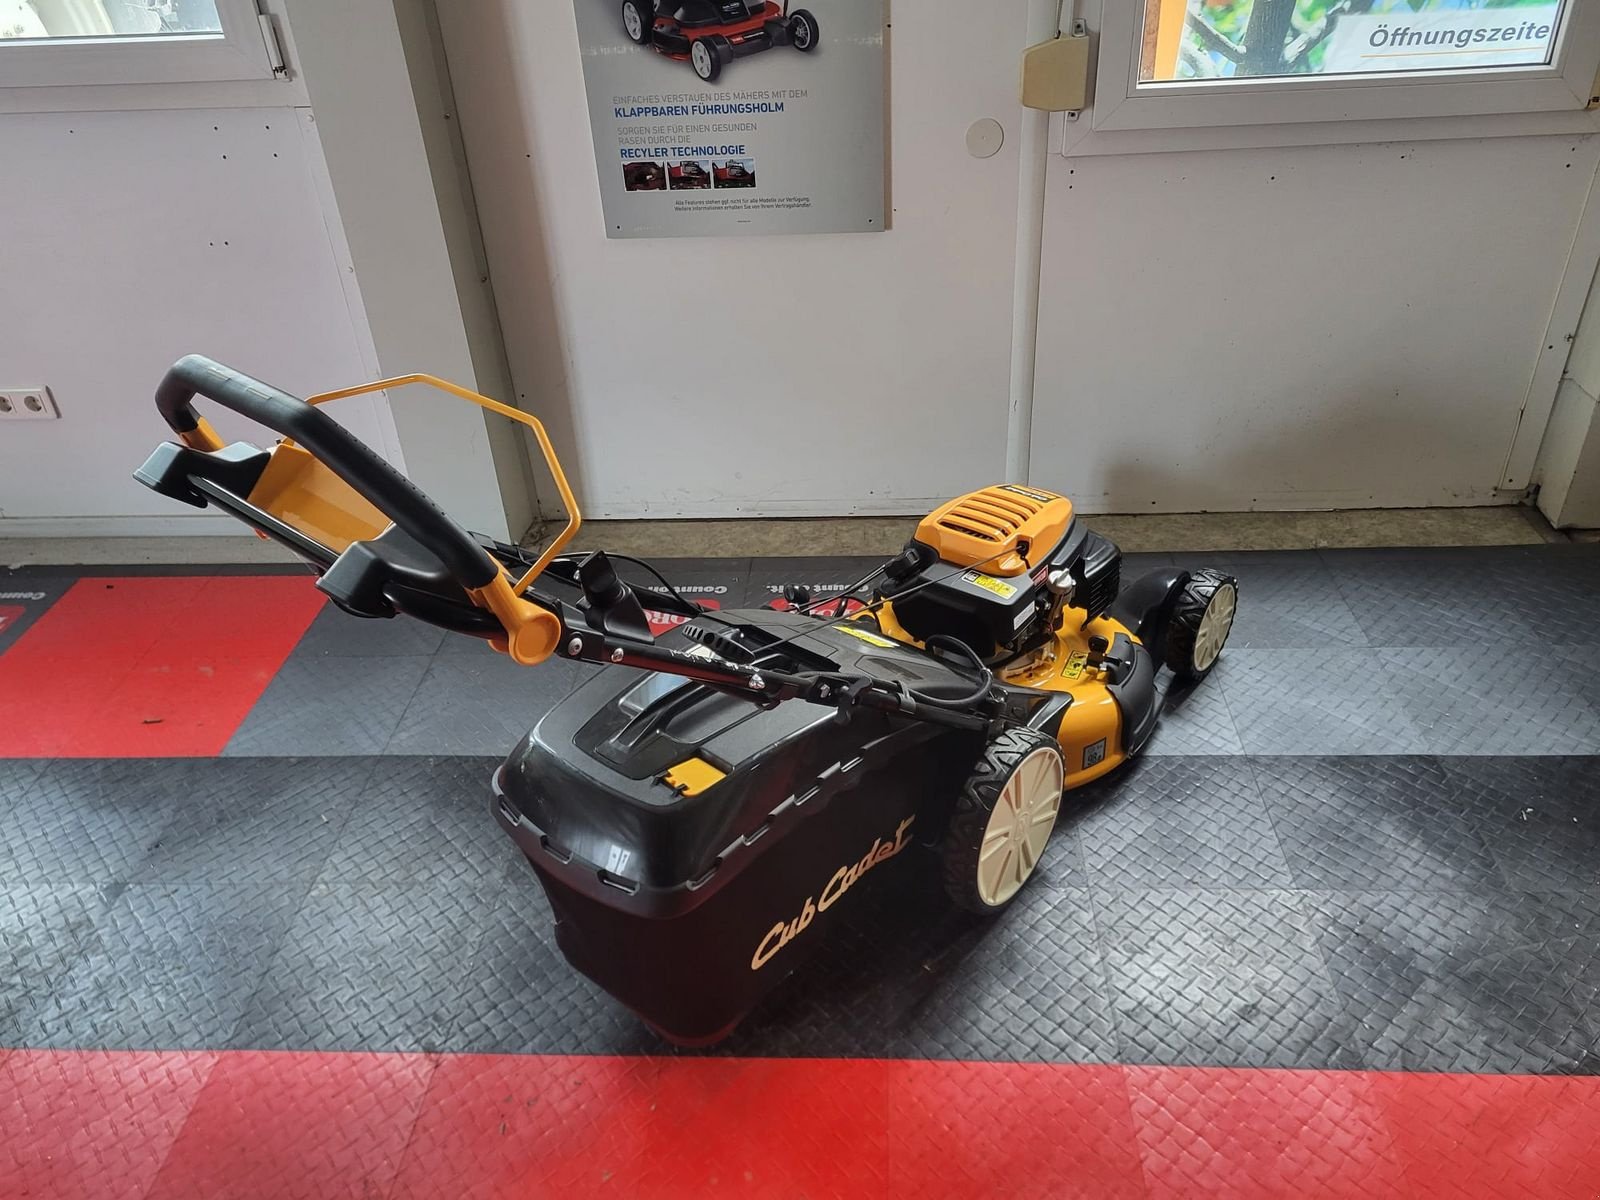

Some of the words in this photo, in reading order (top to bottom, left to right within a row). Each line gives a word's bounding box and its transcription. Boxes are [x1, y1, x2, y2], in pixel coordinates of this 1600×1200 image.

[1369, 21, 1550, 49] Öffnungszeite
[612, 95, 660, 105] EINFACHES
[661, 93, 712, 103] VERSTAUEN
[713, 92, 731, 101] DES
[771, 90, 787, 99] MIT
[788, 89, 808, 98] DEM
[614, 105, 689, 118] KLAPPBAREN
[691, 102, 785, 115] FÜHRUNGSHOLM
[617, 127, 650, 136] SORGEN
[652, 126, 665, 135] SIE
[685, 124, 711, 133] EINEN
[712, 122, 758, 132] GESUNDEN
[618, 136, 647, 145] RASEN
[648, 135, 676, 145] DURCH
[677, 135, 691, 143] DIE
[620, 147, 669, 158] RECYLER
[670, 144, 746, 157] TECHNOLOGIE
[751, 896, 816, 970] Cub
[817, 814, 916, 912] Cadet
